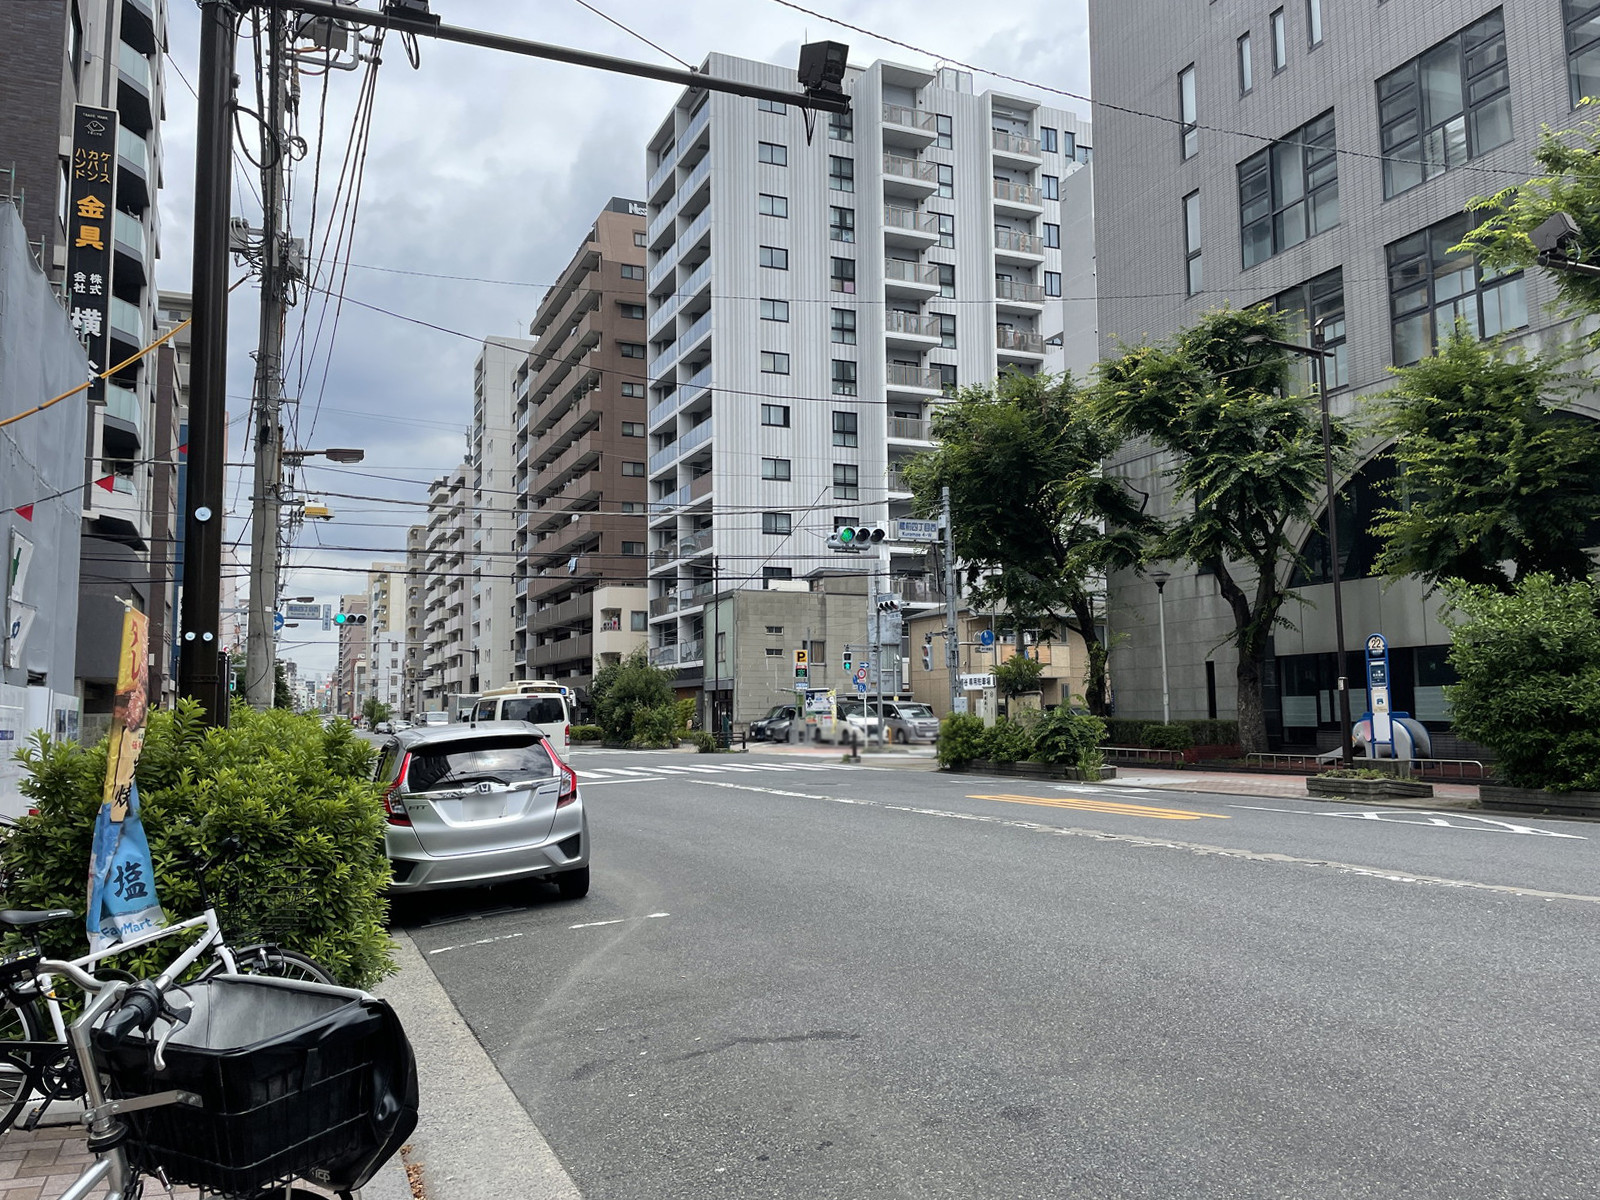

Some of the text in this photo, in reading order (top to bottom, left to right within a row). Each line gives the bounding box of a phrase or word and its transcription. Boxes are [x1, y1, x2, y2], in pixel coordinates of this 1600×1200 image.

[75, 148, 86, 179] ハンド
[87, 150, 99, 181] カバン
[100, 152, 111, 184] ケース
[75, 194, 106, 251] 金具
[1371, 638, 1381, 648] 22
[113, 861, 148, 902] 塩
